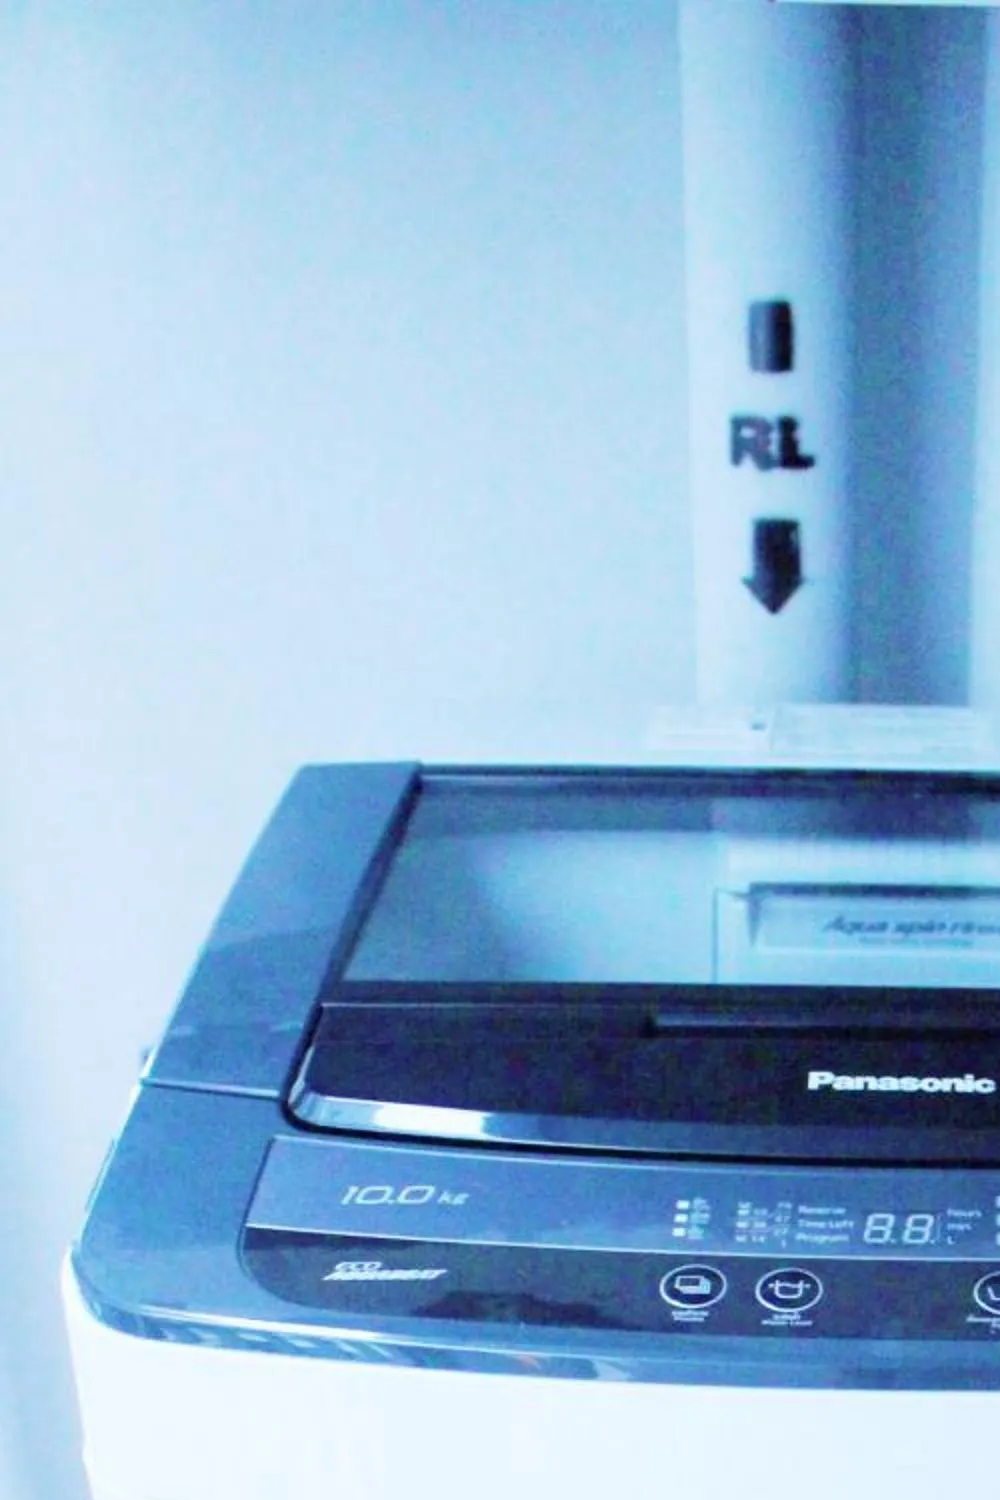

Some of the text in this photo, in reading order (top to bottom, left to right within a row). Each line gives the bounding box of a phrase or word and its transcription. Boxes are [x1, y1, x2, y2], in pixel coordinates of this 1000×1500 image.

[730, 415, 815, 470] RL
[807, 1071, 997, 1094] Panasonic
[340, 1185, 436, 1206] 10.0
